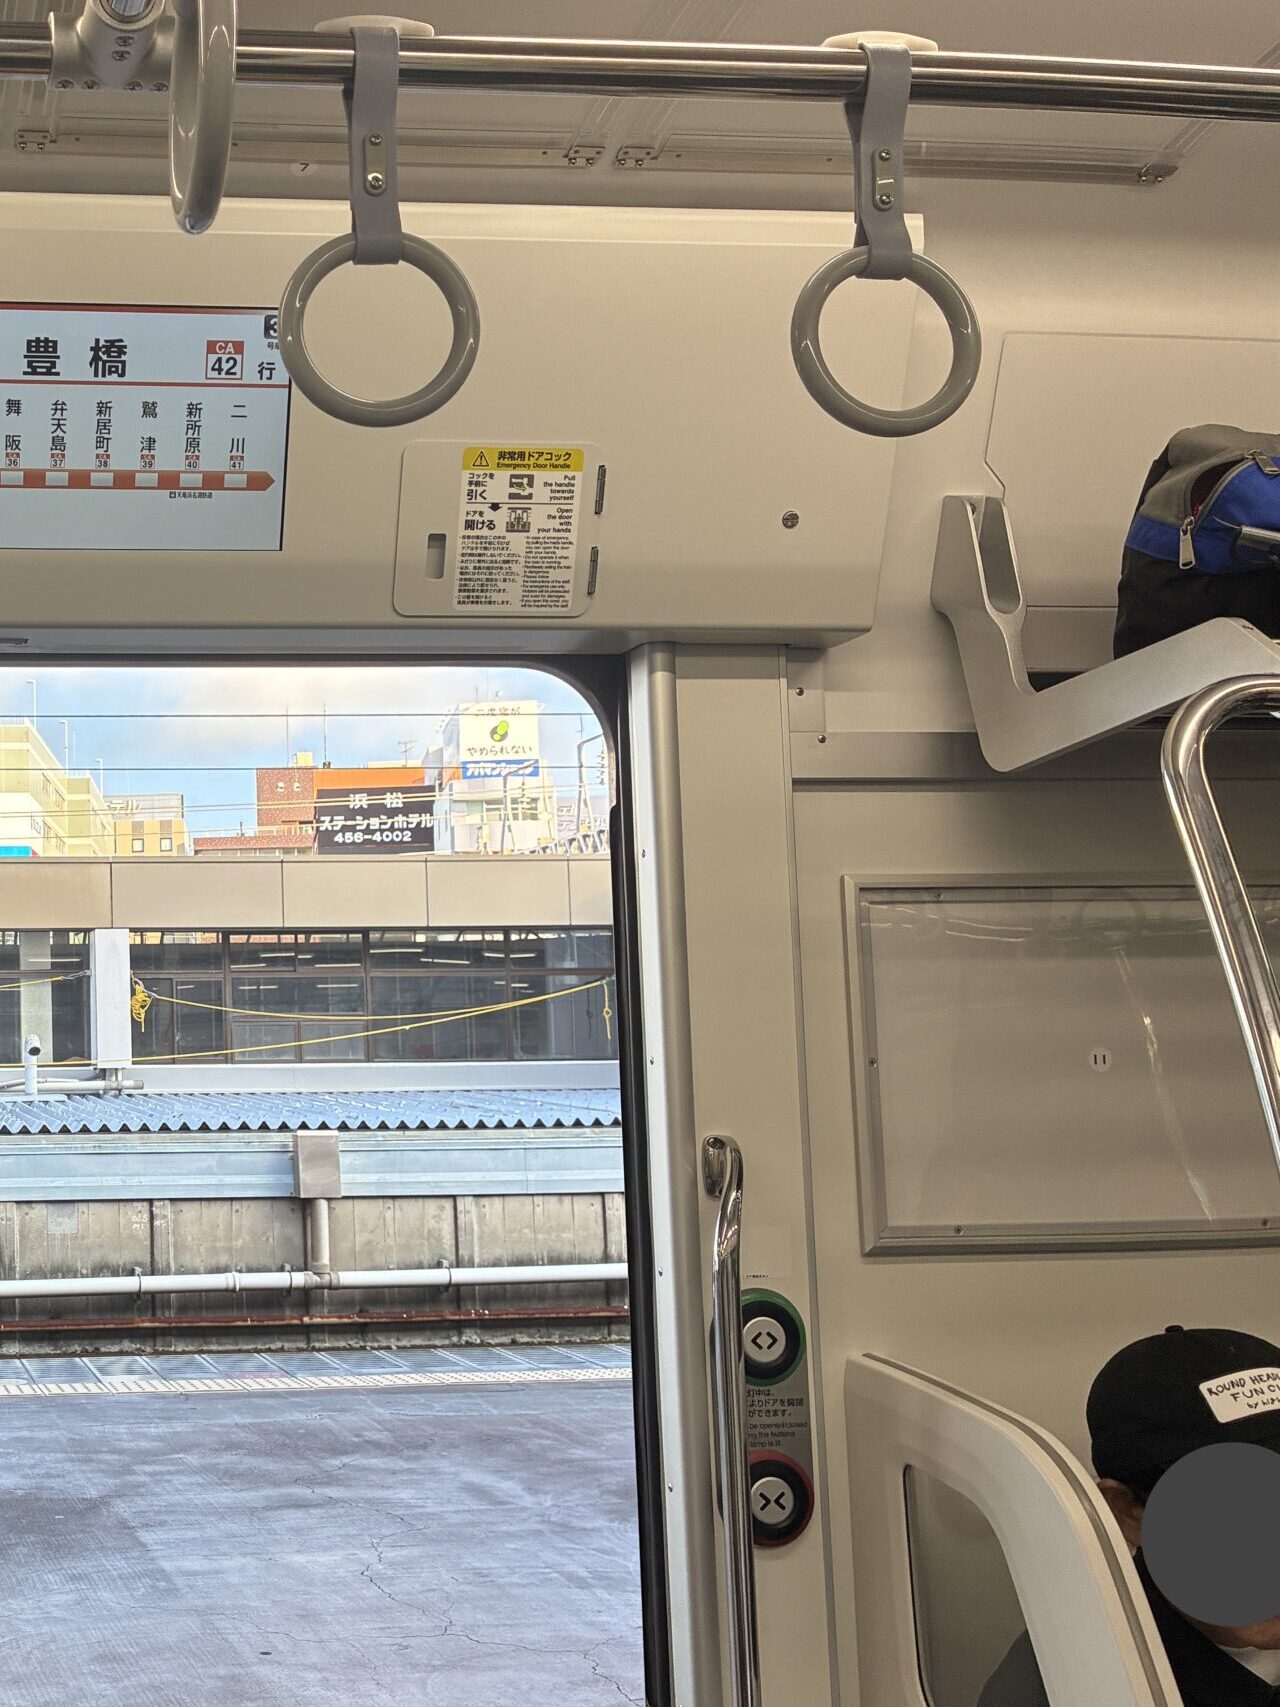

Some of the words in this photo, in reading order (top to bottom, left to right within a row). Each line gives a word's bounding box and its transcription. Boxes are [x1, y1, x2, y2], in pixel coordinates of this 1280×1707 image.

[300, 162, 309, 172] 7
[216, 342, 235, 354] CA
[23, 336, 128, 378] 豊橋
[210, 356, 238, 376] 42
[258, 361, 276, 380] 行
[5, 398, 22, 451] 舞阪
[50, 399, 67, 452] 弁天島
[95, 400, 113, 453] 新居町
[140, 401, 158, 453] 鷲津
[184, 401, 203, 454] 新所原
[229, 404, 247, 454] 二川
[498, 450, 572, 462] 非常用ドアコック
[52, 459, 63, 467] 37
[97, 460, 108, 468] 38
[187, 461, 198, 469] 40
[496, 462, 531, 470] Emergency
[468, 472, 495, 480] コックを
[468, 480, 487, 488] 手前に
[466, 488, 487, 501] 引く
[464, 519, 496, 531] 開ける
[467, 745, 533, 757] やめられない
[349, 792, 404, 810] 浜松
[320, 813, 434, 831] ステーションホテル
[333, 831, 412, 844] 456-4002
[1207, 1377, 1247, 1396] ROUND
[1230, 1386, 1265, 1402] FUN
[1247, 1401, 1259, 1409] by
